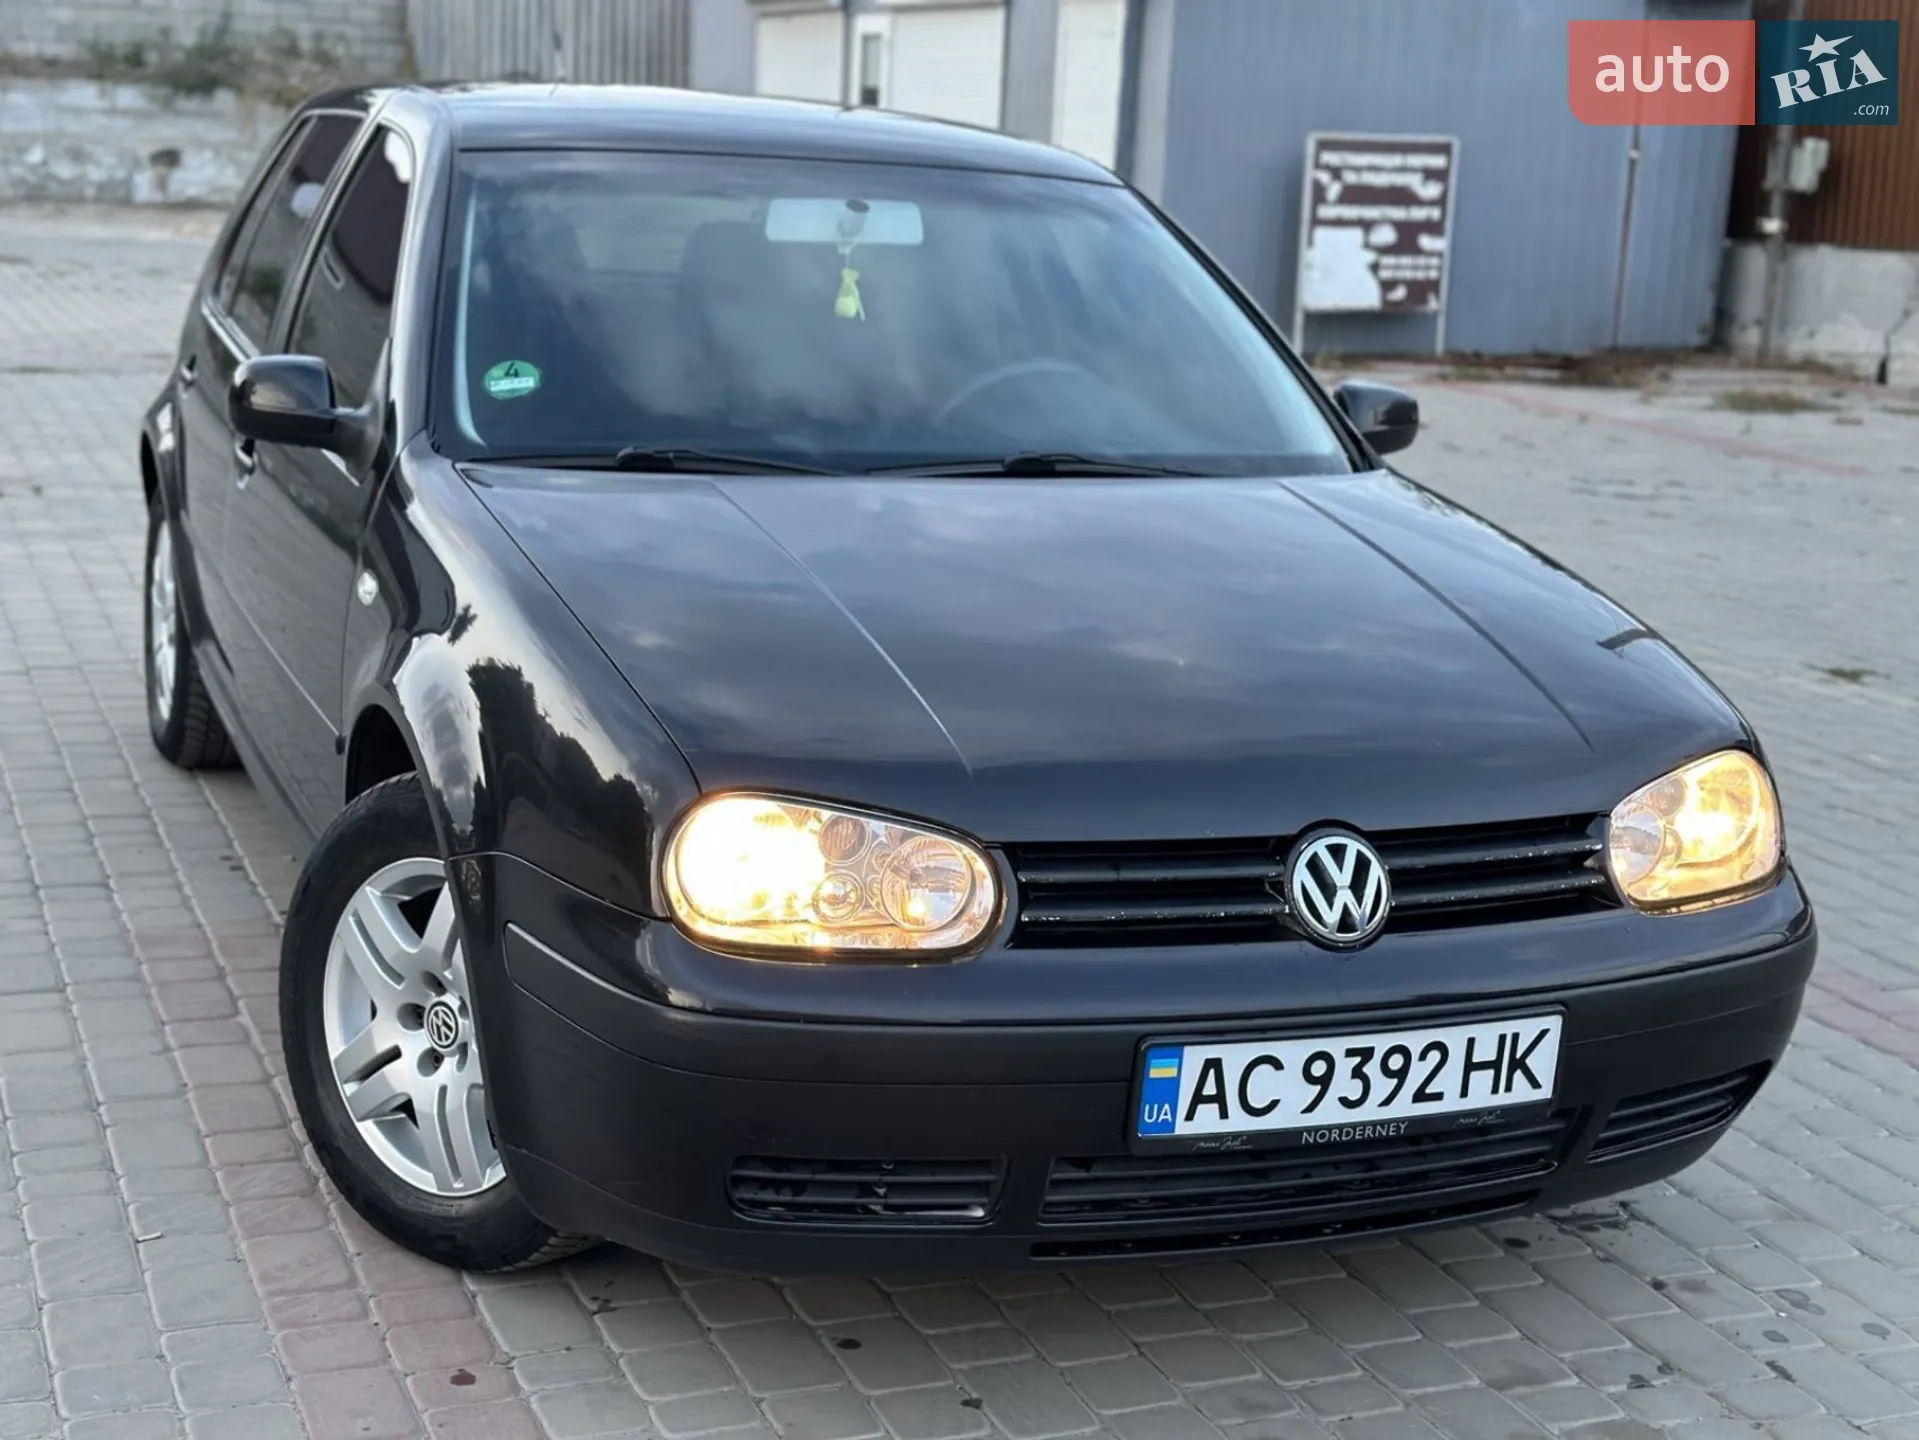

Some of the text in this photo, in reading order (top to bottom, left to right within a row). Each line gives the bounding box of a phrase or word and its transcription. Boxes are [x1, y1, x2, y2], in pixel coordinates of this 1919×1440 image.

[504, 361, 520, 378] 4
[1292, 835, 1388, 941] VW
[1183, 1028, 1551, 1122] AC 9392 HK
[1144, 1105, 1172, 1125] UA
[1301, 1121, 1409, 1145] NORDERNEY
